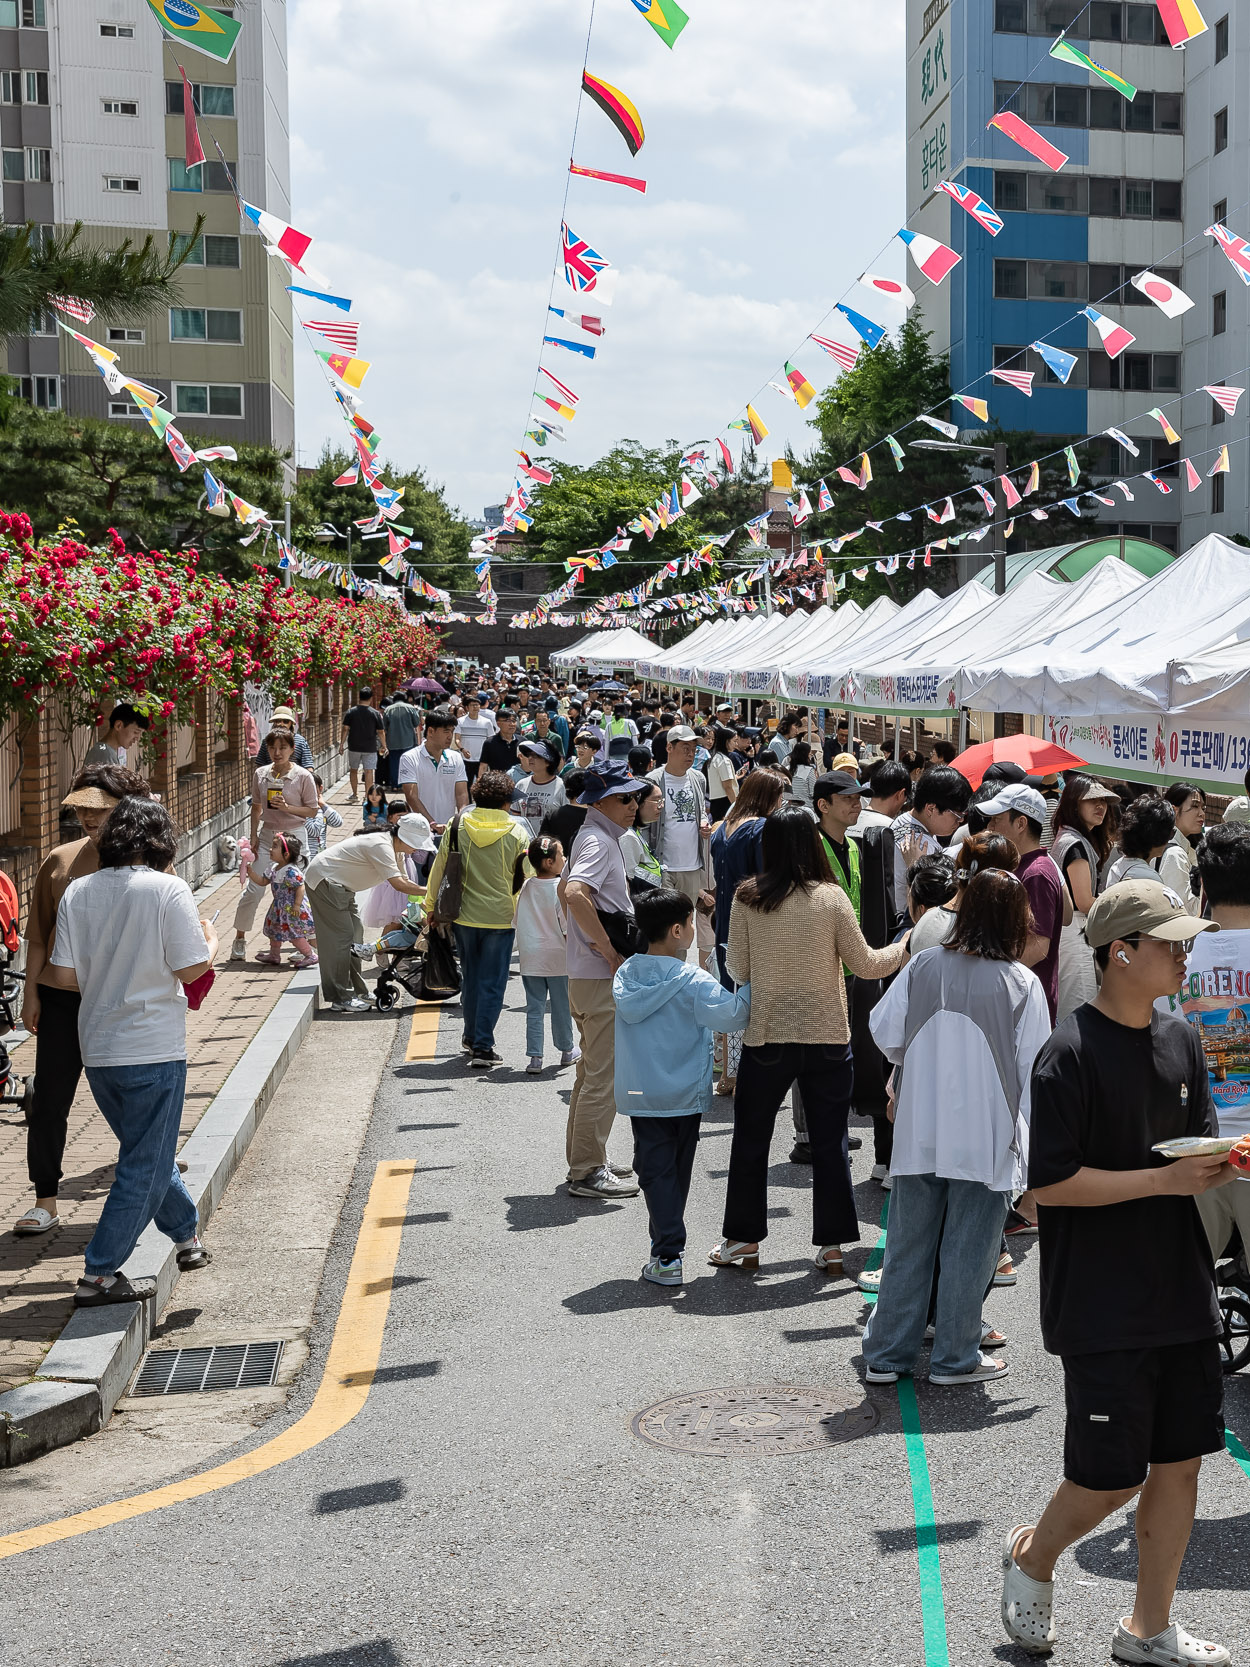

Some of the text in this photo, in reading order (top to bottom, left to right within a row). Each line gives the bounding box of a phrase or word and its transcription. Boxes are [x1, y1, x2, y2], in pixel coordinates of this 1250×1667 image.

[921, 121, 948, 190] 홈타운
[1113, 725, 1148, 760] 풍선아트
[1212, 1084, 1249, 1095] Hard Rock
